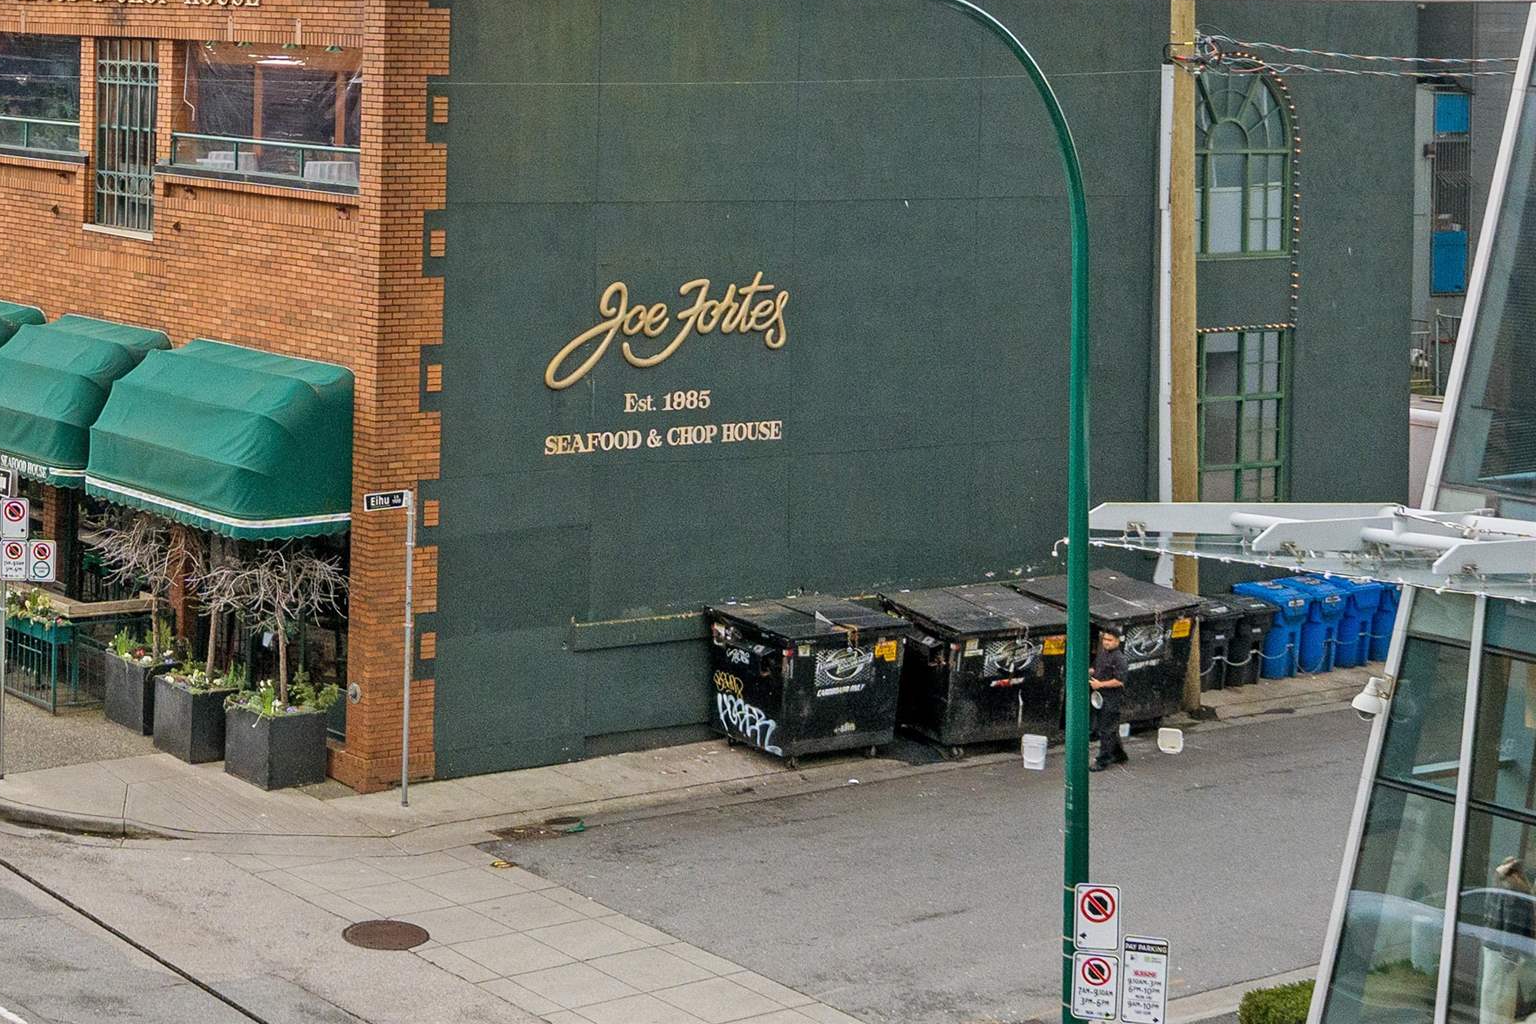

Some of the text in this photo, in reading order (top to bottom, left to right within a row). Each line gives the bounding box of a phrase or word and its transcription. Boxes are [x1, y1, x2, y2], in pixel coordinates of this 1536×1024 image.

[544, 271, 790, 389] Joe Fortes
[624, 390, 711, 413] Est. 1985
[544, 420, 783, 456] SEAFOOD & CHOP HOUSE
[1, 454, 27, 473] SEAFOOD
[27, 461, 47, 479] HOUSE
[370, 496, 390, 506] Eihu
[1125, 943, 1167, 954] PAY PARKING
